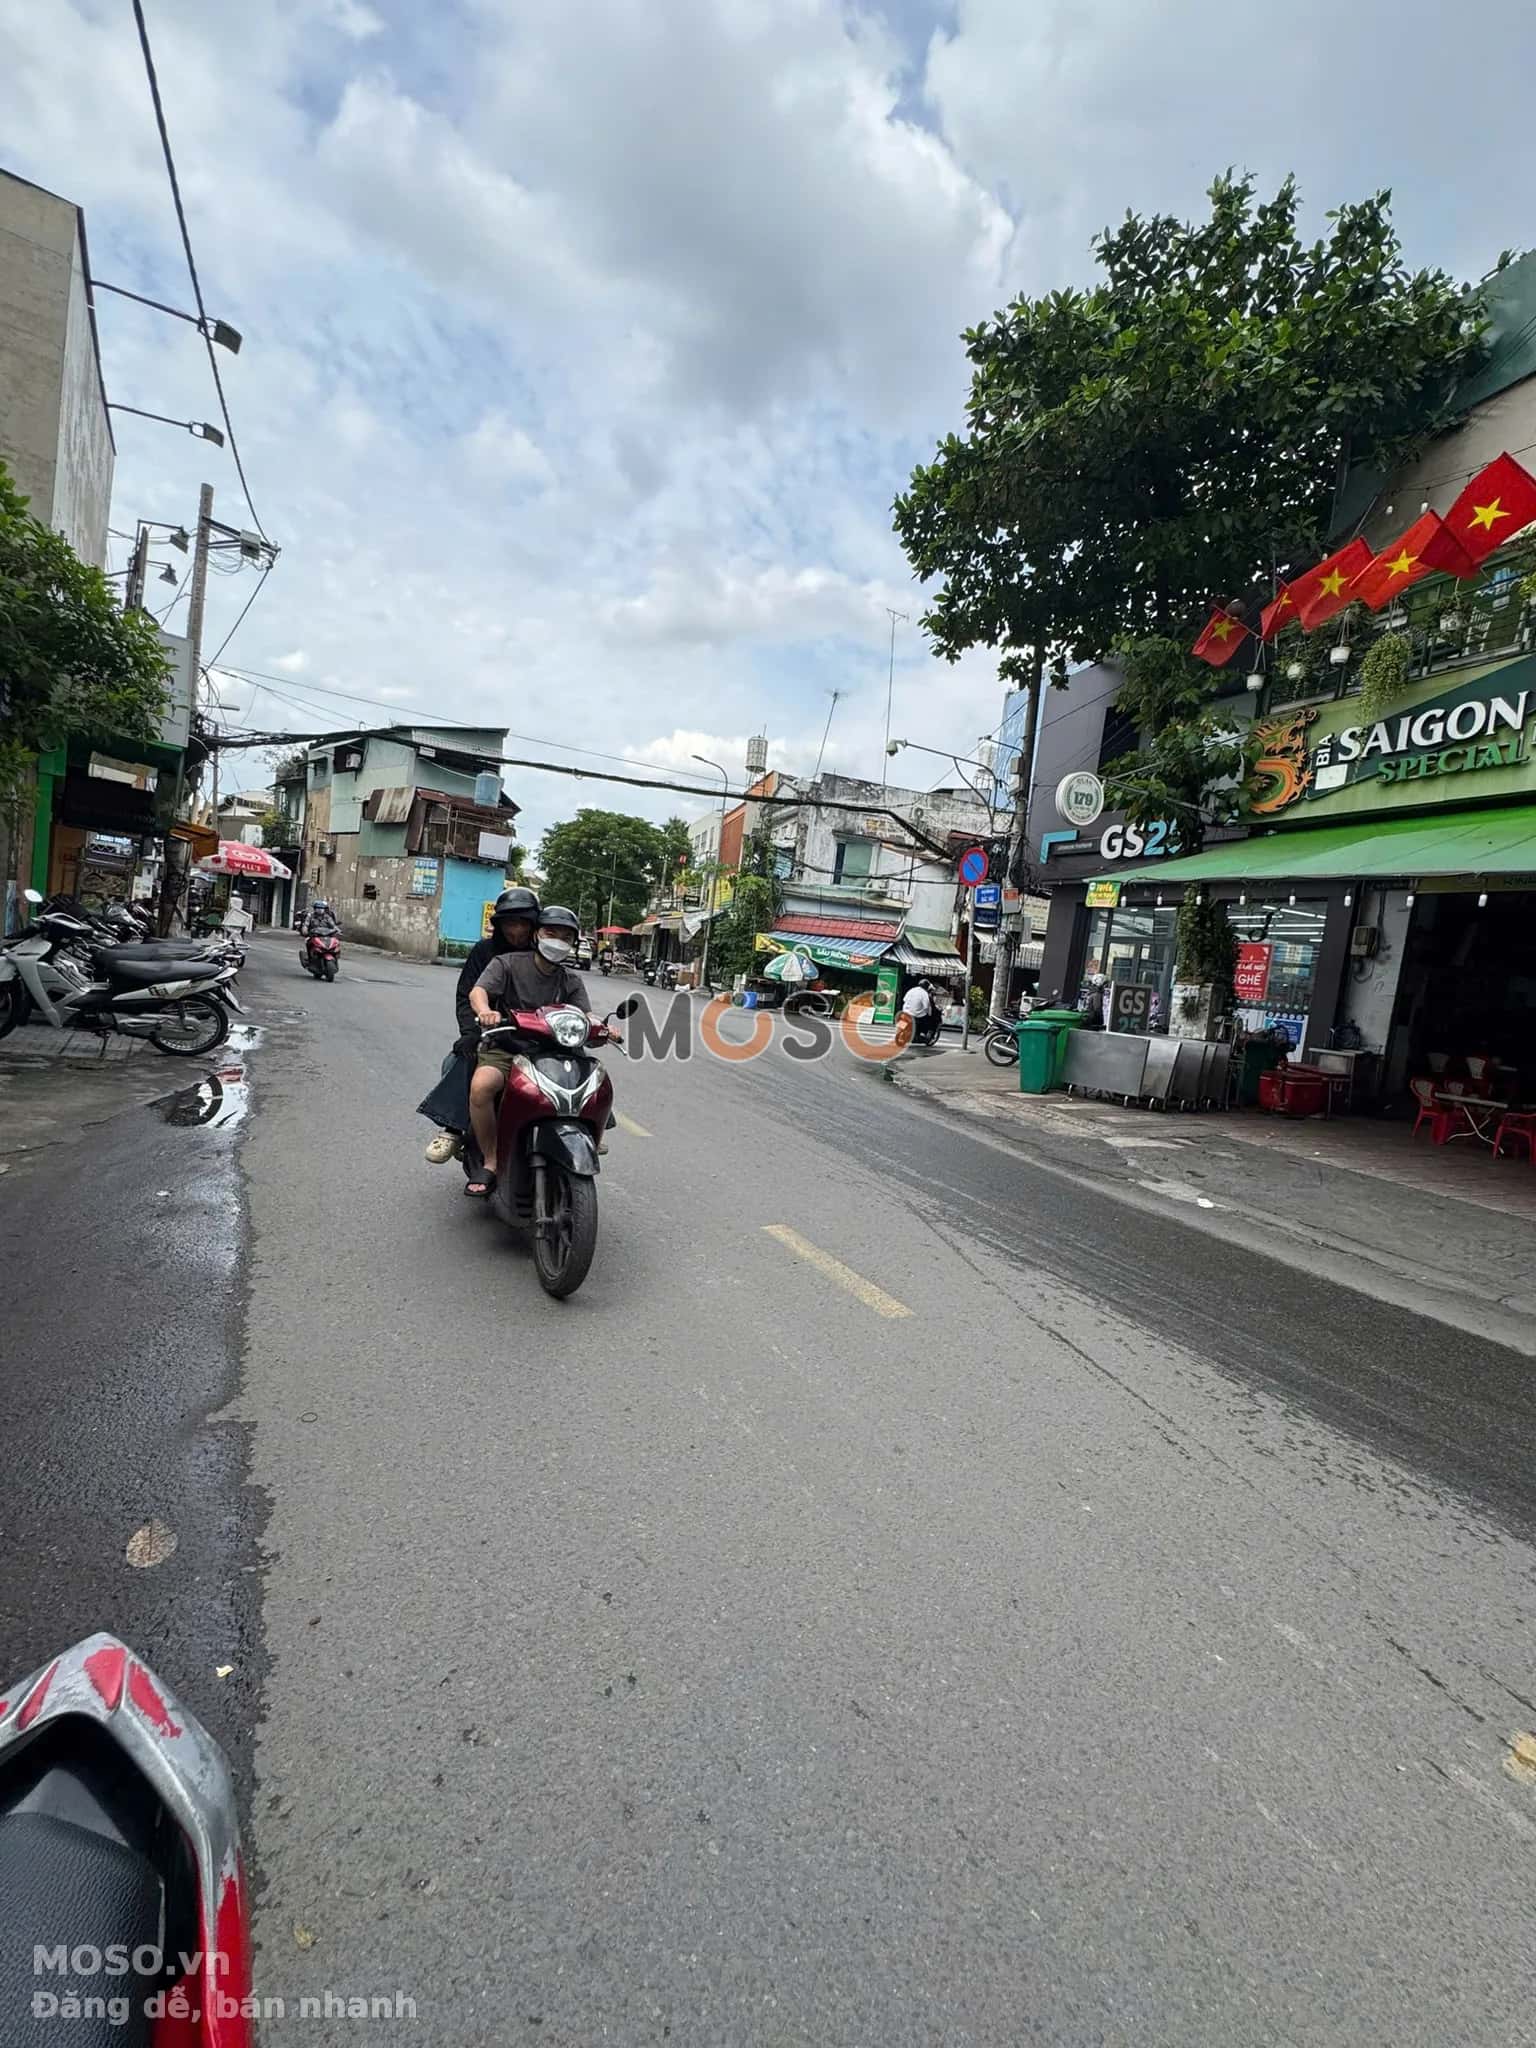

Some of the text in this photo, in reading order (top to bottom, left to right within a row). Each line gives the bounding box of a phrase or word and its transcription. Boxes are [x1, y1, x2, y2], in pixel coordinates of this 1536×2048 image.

[1338, 690, 1530, 762] SAIGON
[1315, 733, 1333, 767] BIA
[1376, 740, 1530, 784] SPECIAL
[1073, 791, 1094, 807] 179
[233, 861, 262, 872] WALL'S
[1119, 989, 1146, 1015] GS
